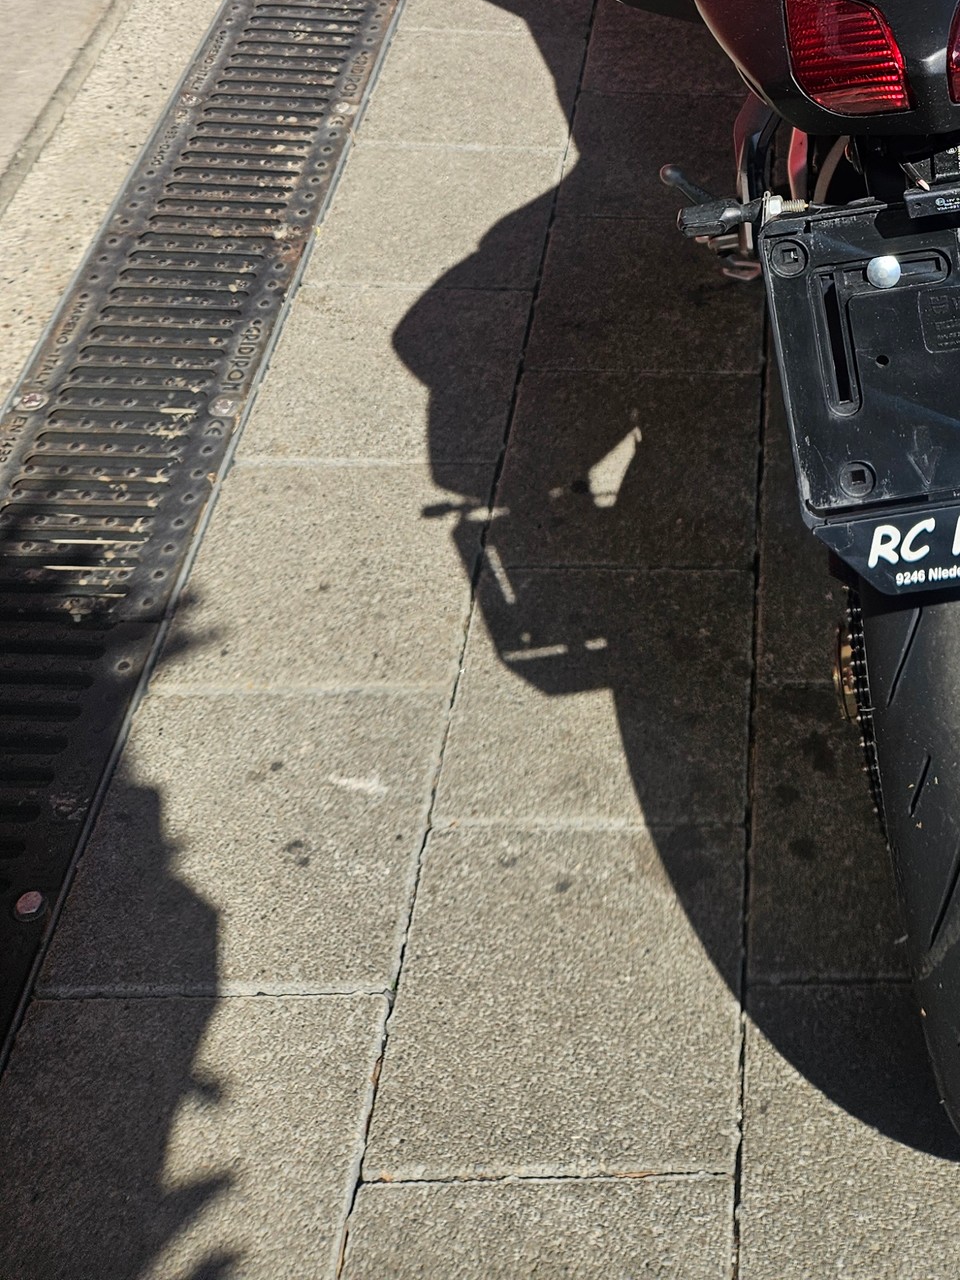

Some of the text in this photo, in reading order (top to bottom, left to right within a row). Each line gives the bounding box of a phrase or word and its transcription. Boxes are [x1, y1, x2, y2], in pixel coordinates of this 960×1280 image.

[340, 55, 368, 97] GRIDIRON
[34, 353, 60, 387] ITALY
[221, 325, 261, 392] GRIDIRON
[10, 415, 28, 433] EN
[868, 517, 936, 569] RC
[895, 569, 926, 586] 9246
